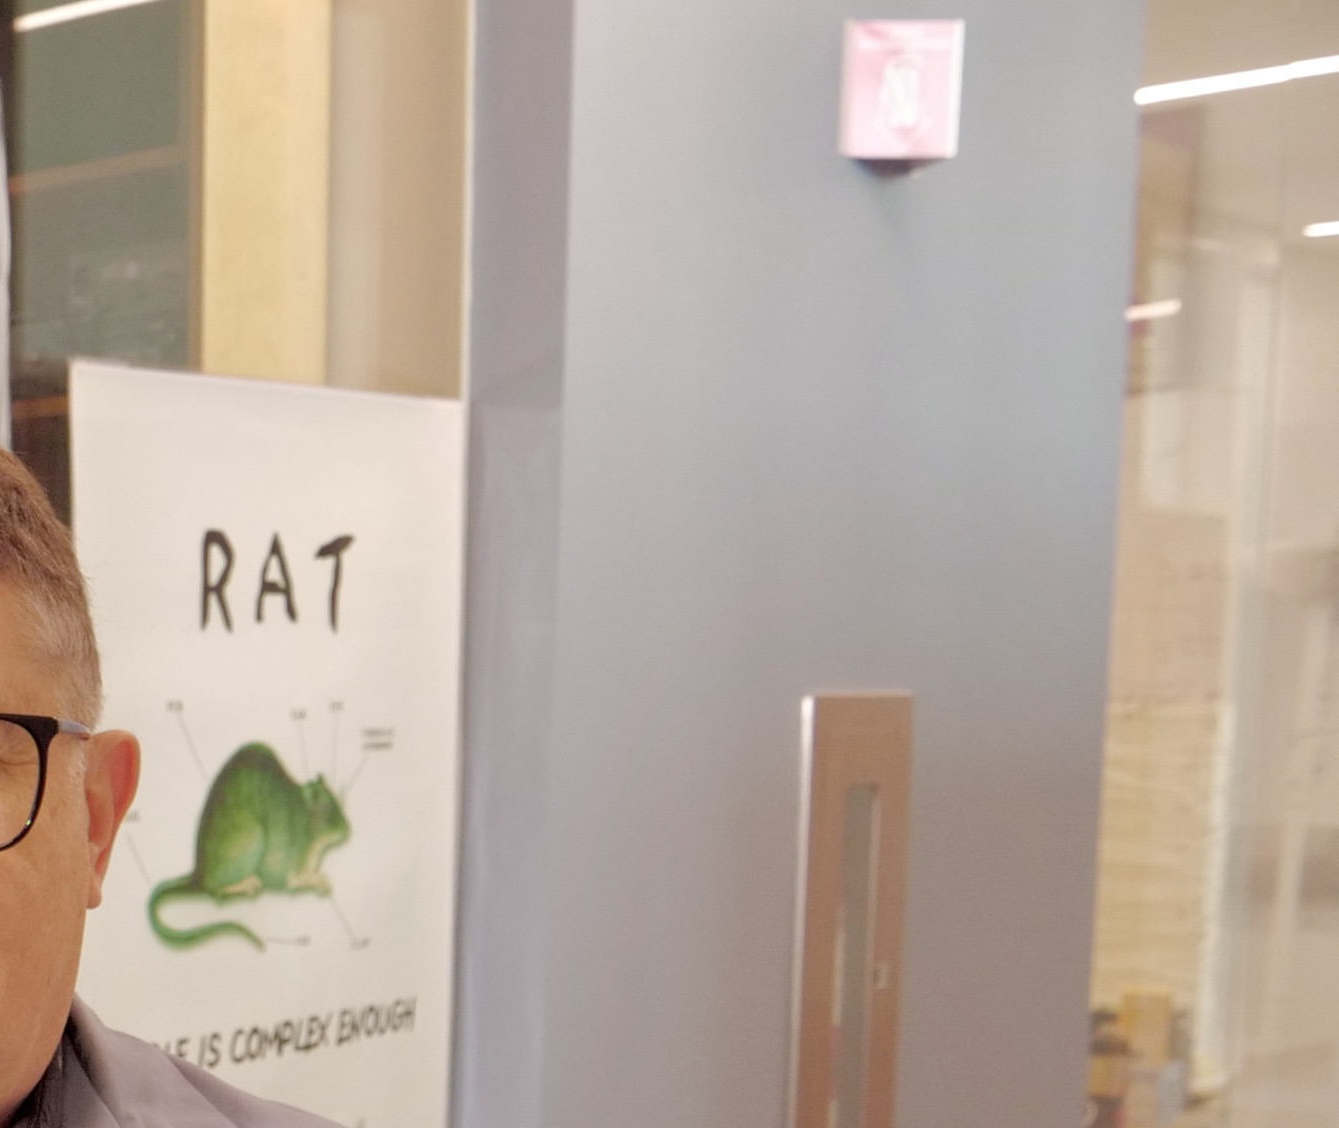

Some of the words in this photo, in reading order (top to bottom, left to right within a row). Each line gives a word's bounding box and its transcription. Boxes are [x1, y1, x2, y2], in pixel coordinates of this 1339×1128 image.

[199, 528, 355, 634] RAT
[197, 1032, 223, 1069] IS
[229, 1011, 335, 1074] COMPLEX
[335, 996, 418, 1048] ENOUGH
